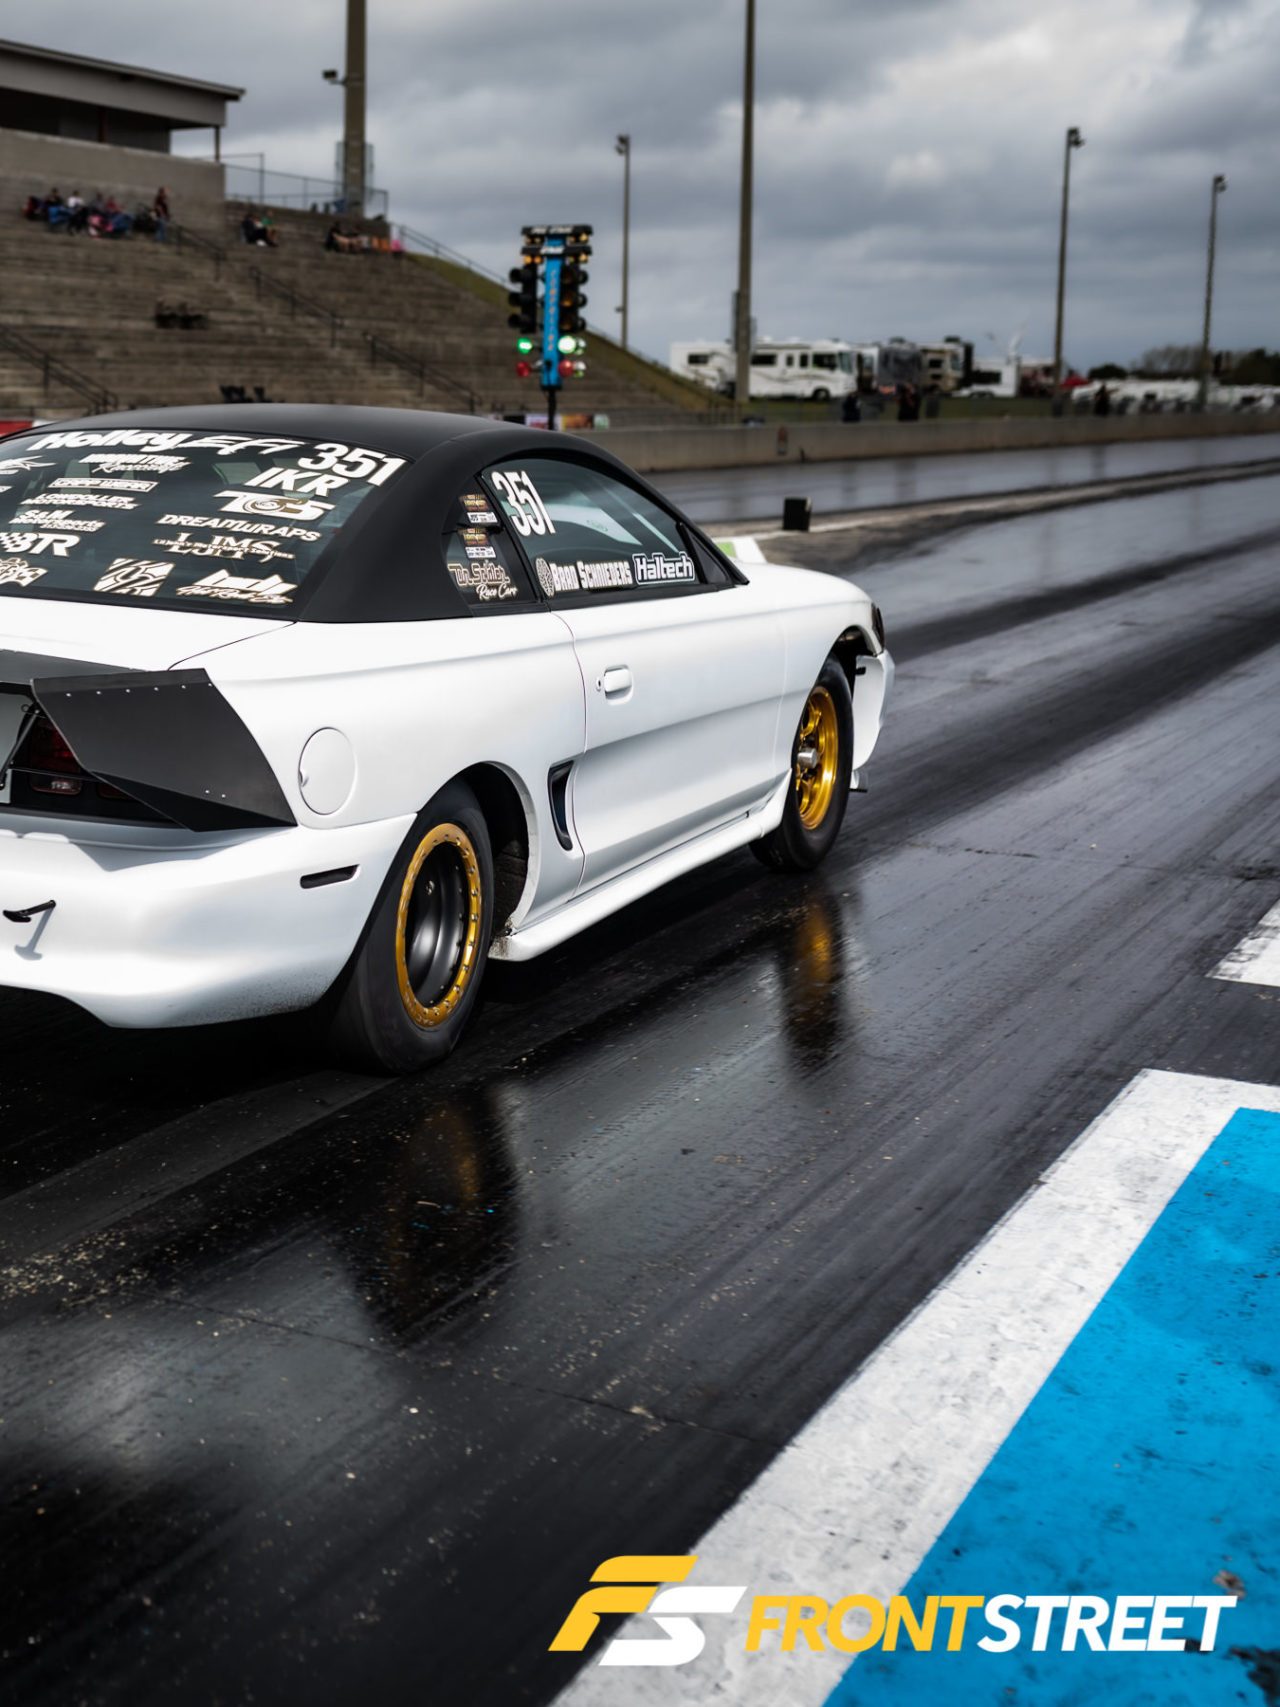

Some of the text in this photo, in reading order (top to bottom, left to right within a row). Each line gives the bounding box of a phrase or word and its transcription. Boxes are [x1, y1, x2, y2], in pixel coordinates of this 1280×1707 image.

[27, 430, 194, 453] Holley
[296, 443, 407, 487] 351
[243, 466, 351, 498] IKR
[491, 470, 557, 537] 351
[549, 562, 580, 592] BRAD
[633, 553, 695, 583] Haltech
